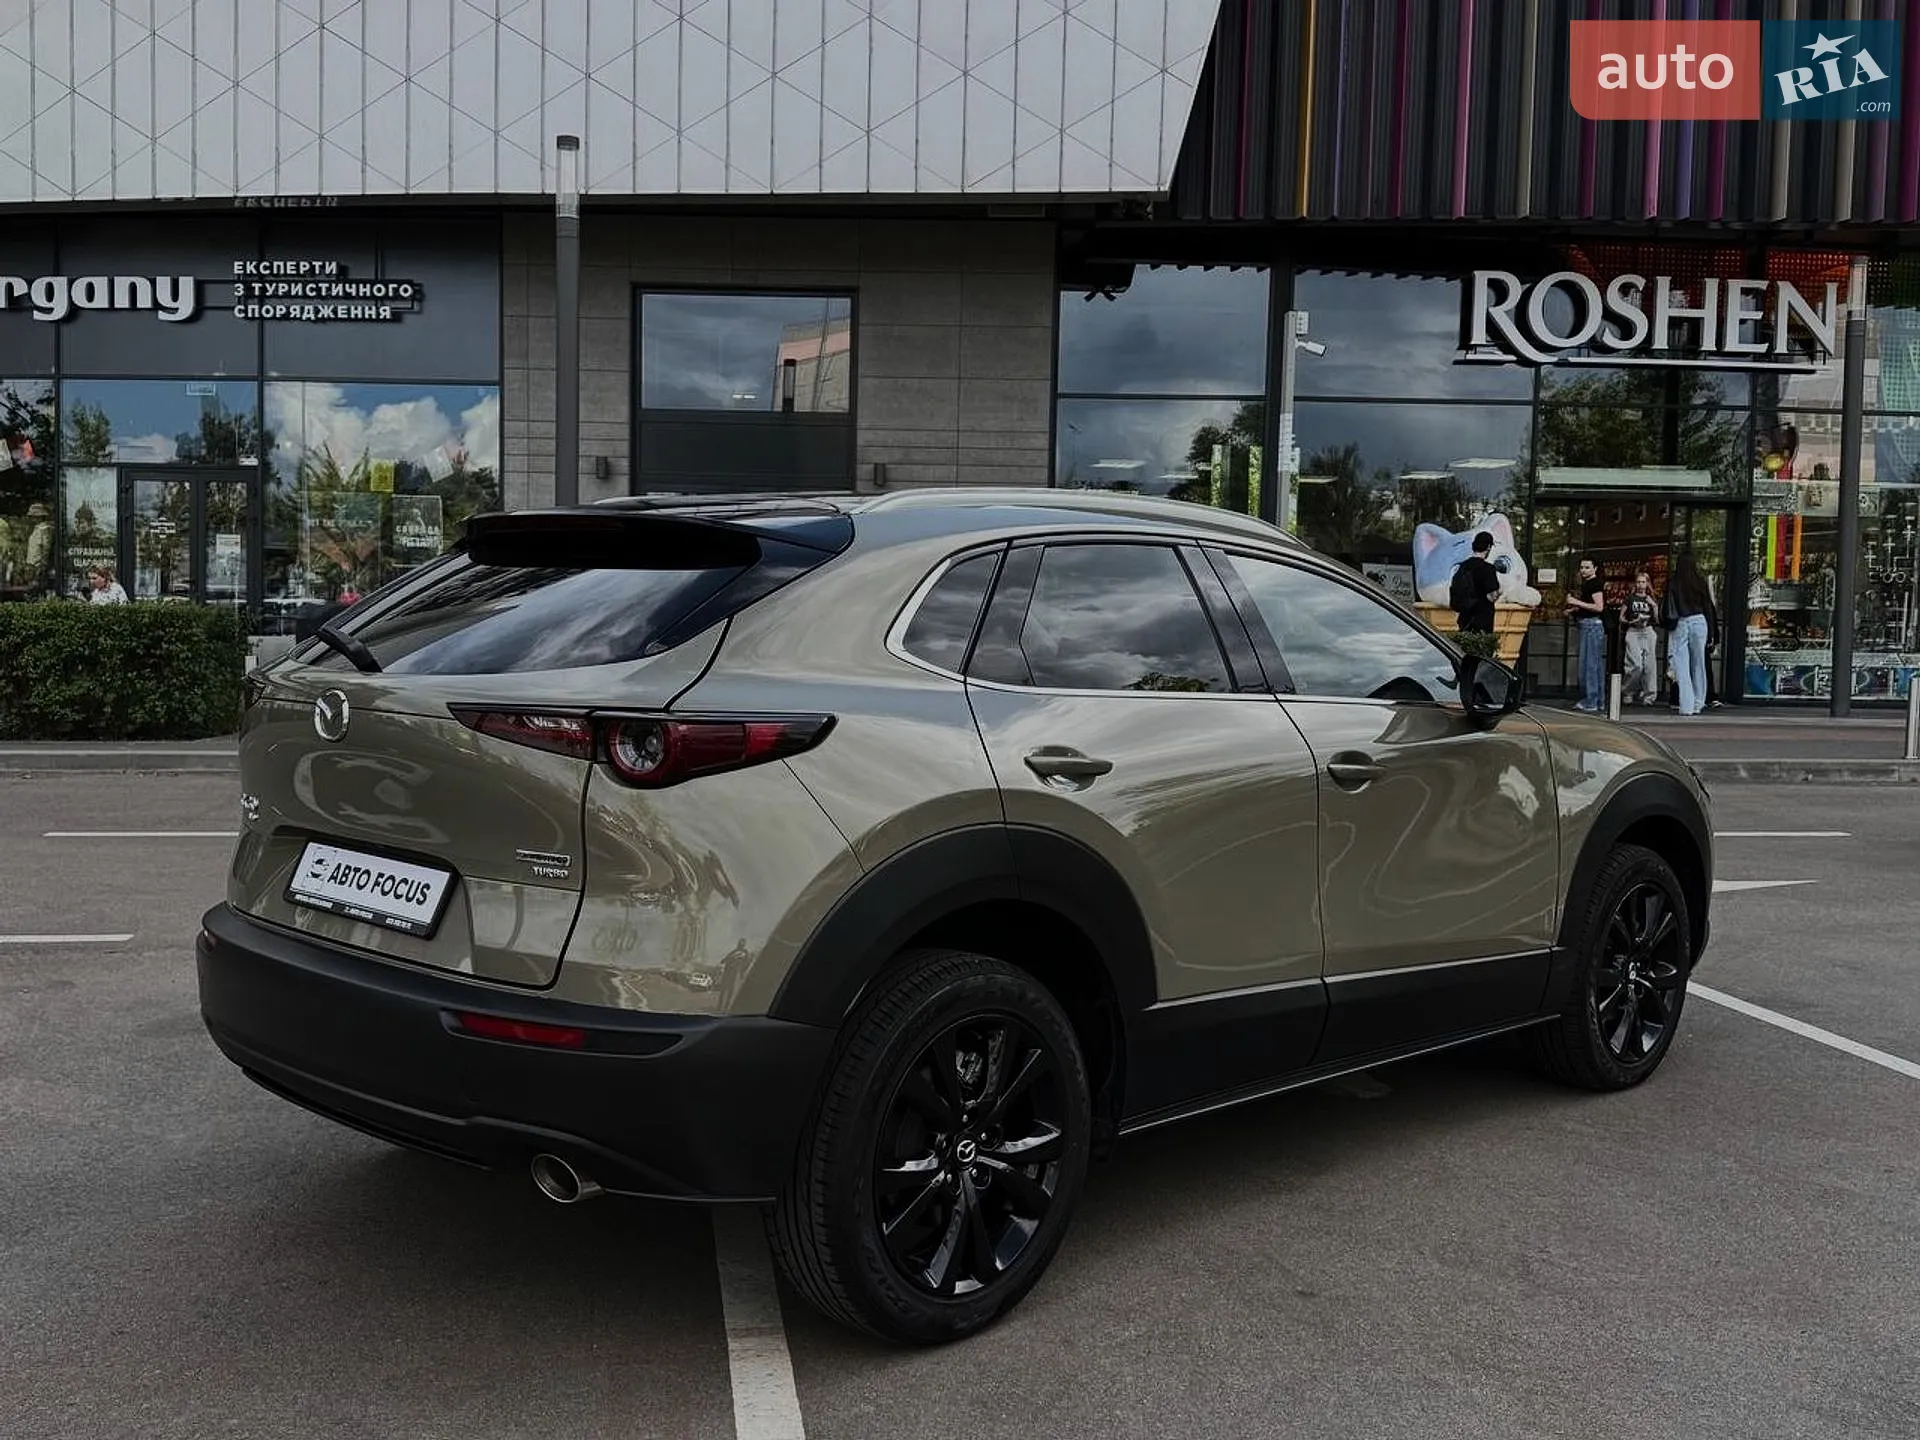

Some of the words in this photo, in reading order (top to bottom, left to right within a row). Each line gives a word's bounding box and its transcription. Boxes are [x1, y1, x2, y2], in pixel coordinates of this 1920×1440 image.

[233, 261, 338, 275] ЕКСПЕРТИ
[0, 275, 196, 321] rgany
[252, 283, 413, 297] ТУРИСТИЧНОГО
[233, 304, 392, 320] СПОРЯДЖЕННЯ
[1469, 270, 1838, 363] ROSHEN
[370, 871, 431, 905] FOCUS
